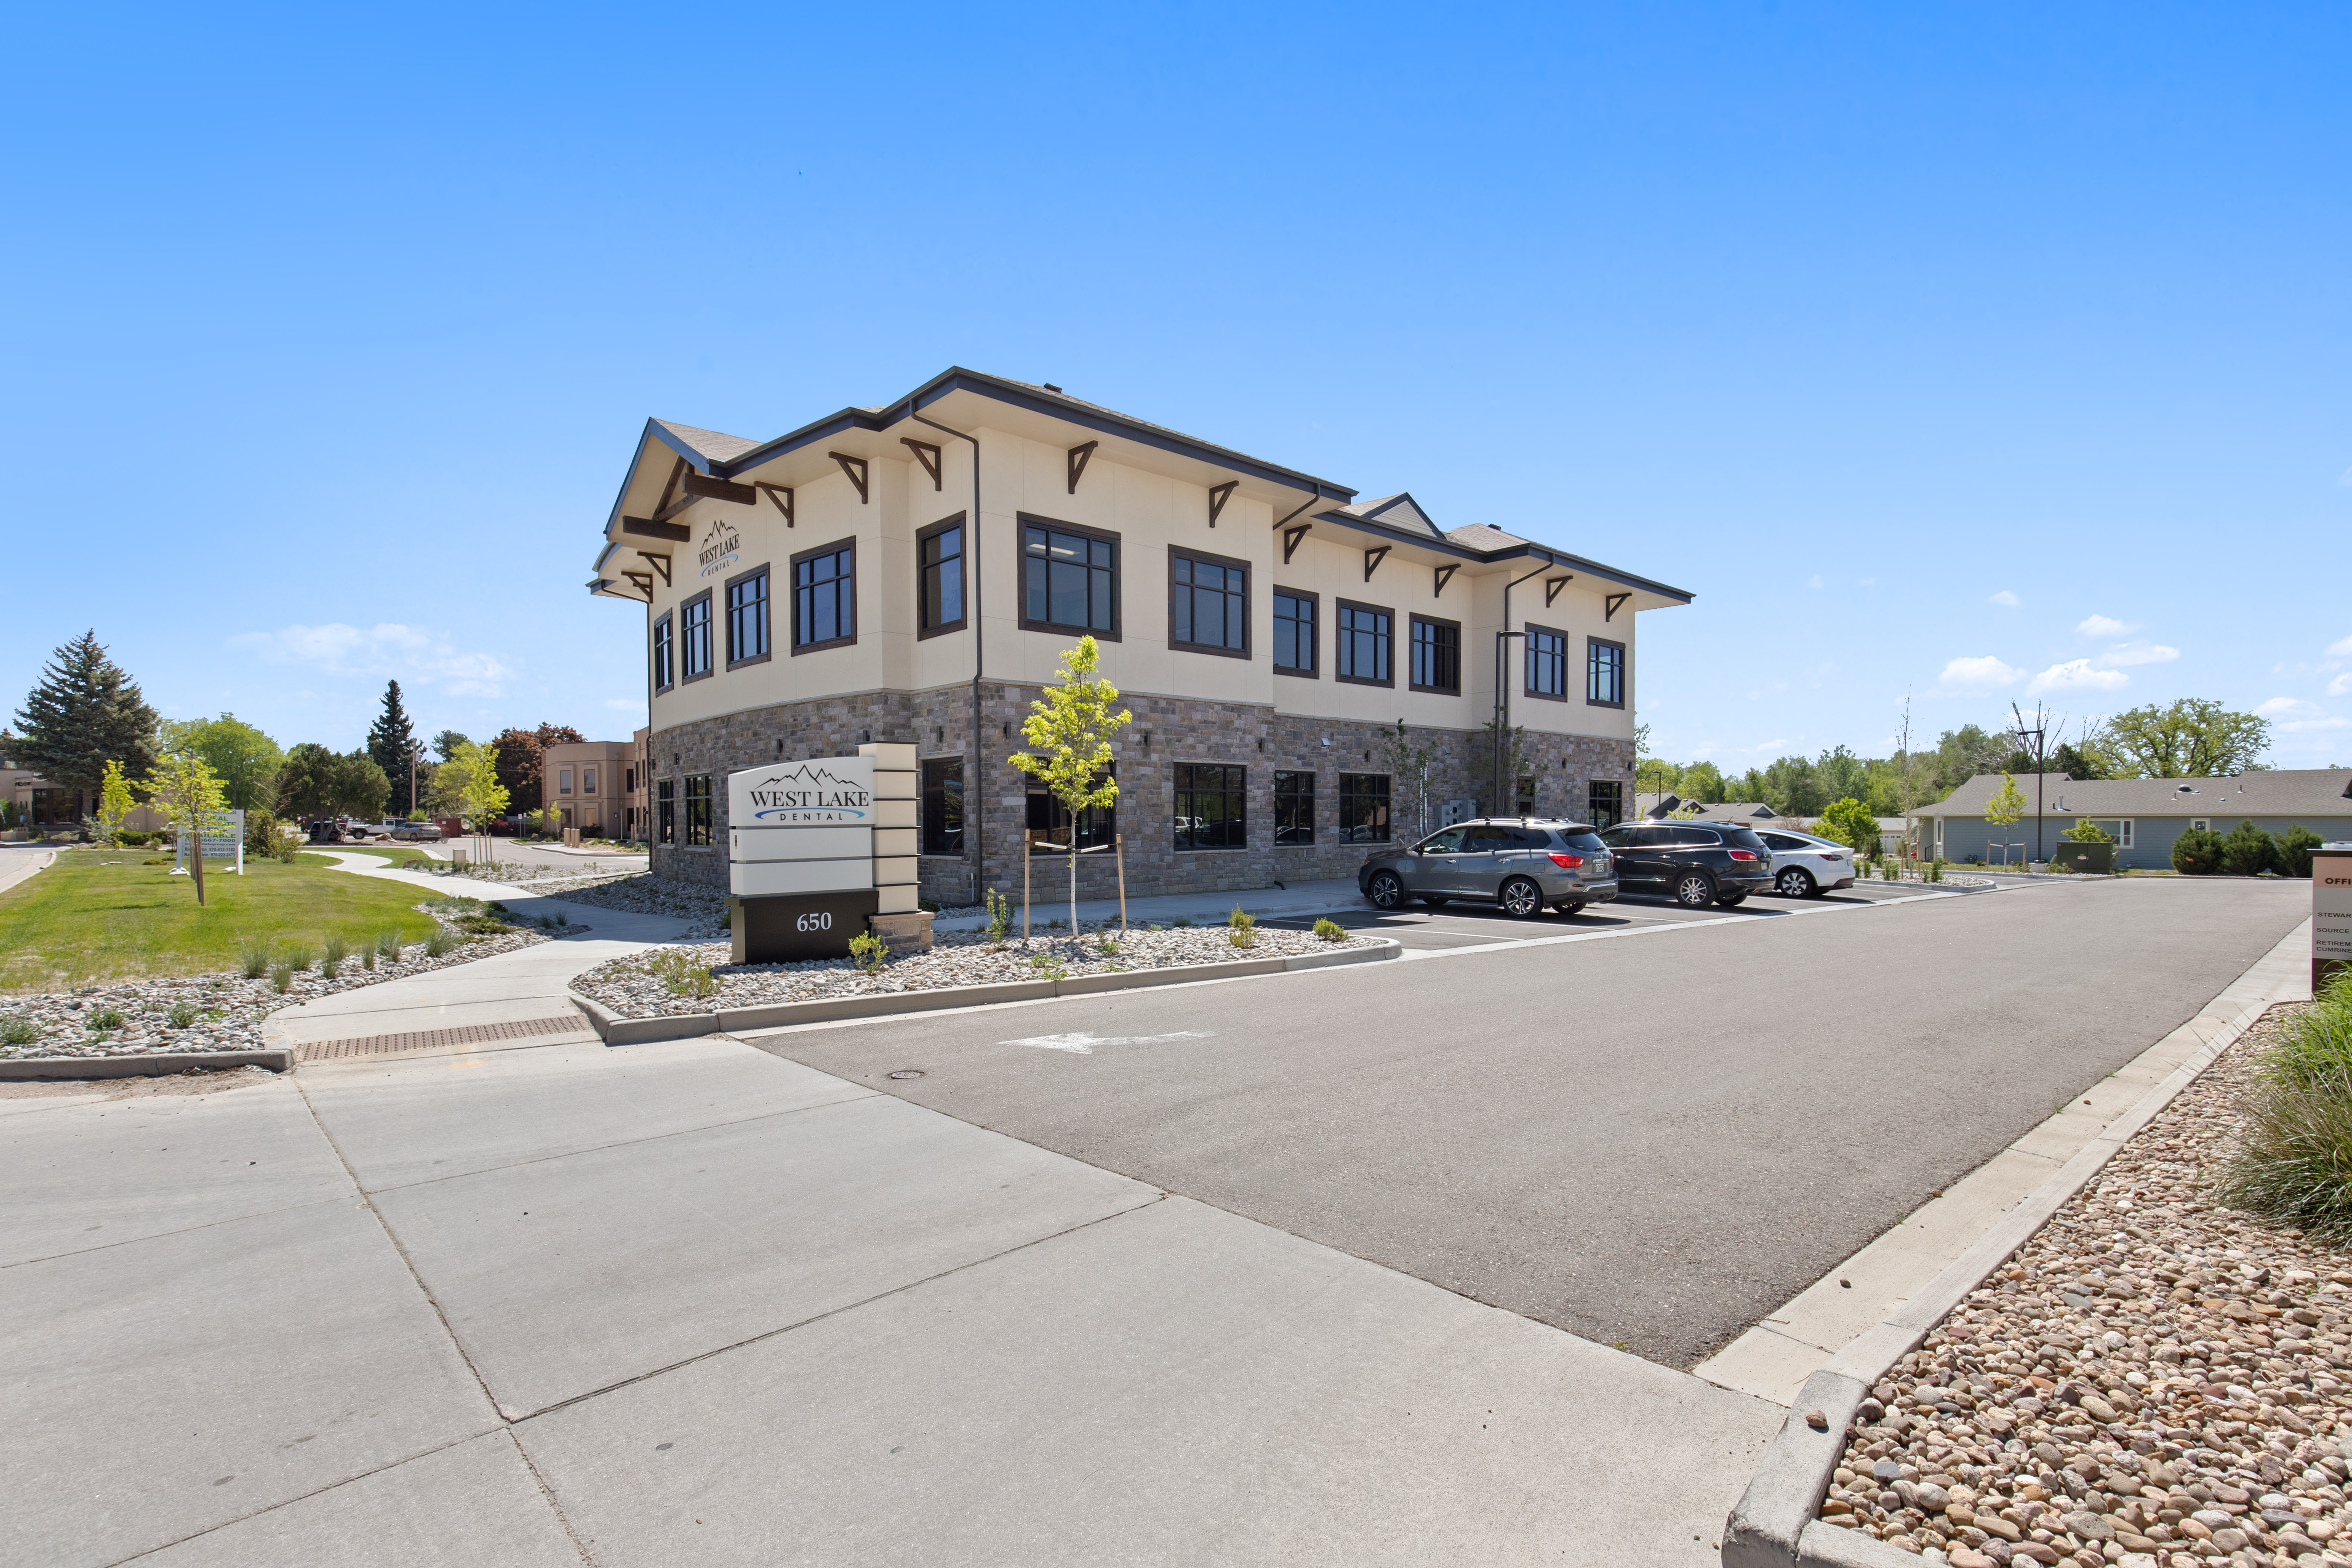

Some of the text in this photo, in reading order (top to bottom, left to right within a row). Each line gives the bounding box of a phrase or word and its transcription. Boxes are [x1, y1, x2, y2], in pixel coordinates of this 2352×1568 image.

[699, 534, 740, 567] WEST LAKE
[708, 560, 730, 576] DENTAL
[749, 791, 869, 807] WEST LAKE
[796, 912, 831, 932] 650
